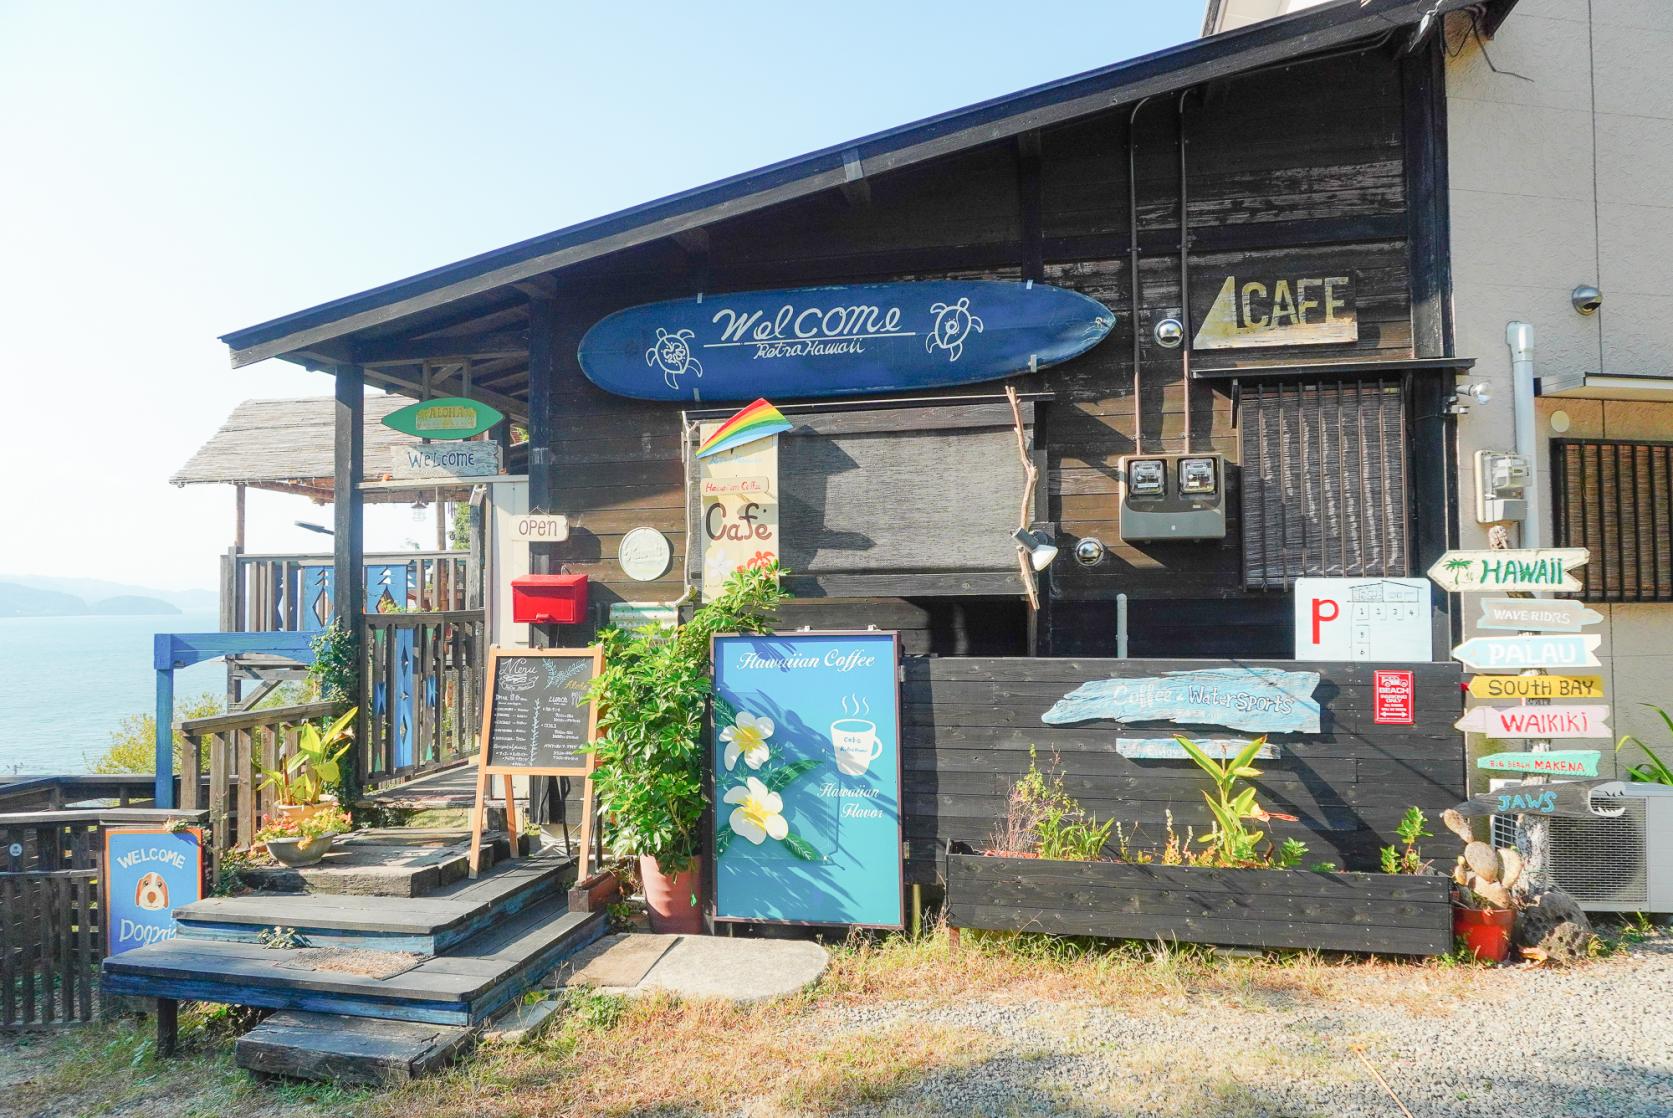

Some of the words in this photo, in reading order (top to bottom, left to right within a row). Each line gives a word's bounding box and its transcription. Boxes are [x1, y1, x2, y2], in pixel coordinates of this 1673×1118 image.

[1242, 276, 1348, 327] CAFE
[1312, 598, 1340, 645] P
[1493, 609, 1528, 622] WAVE
[736, 651, 820, 670] Hawaiian
[823, 648, 876, 672] Coffee
[1488, 642, 1577, 666] PALAU
[1559, 680, 1594, 696] BAY
[1534, 760, 1585, 772] MAKENA
[816, 782, 880, 798] Hawaiian
[1497, 790, 1558, 813] JAWS
[840, 802, 884, 818] Flavor
[116, 847, 186, 870] WELCOME
